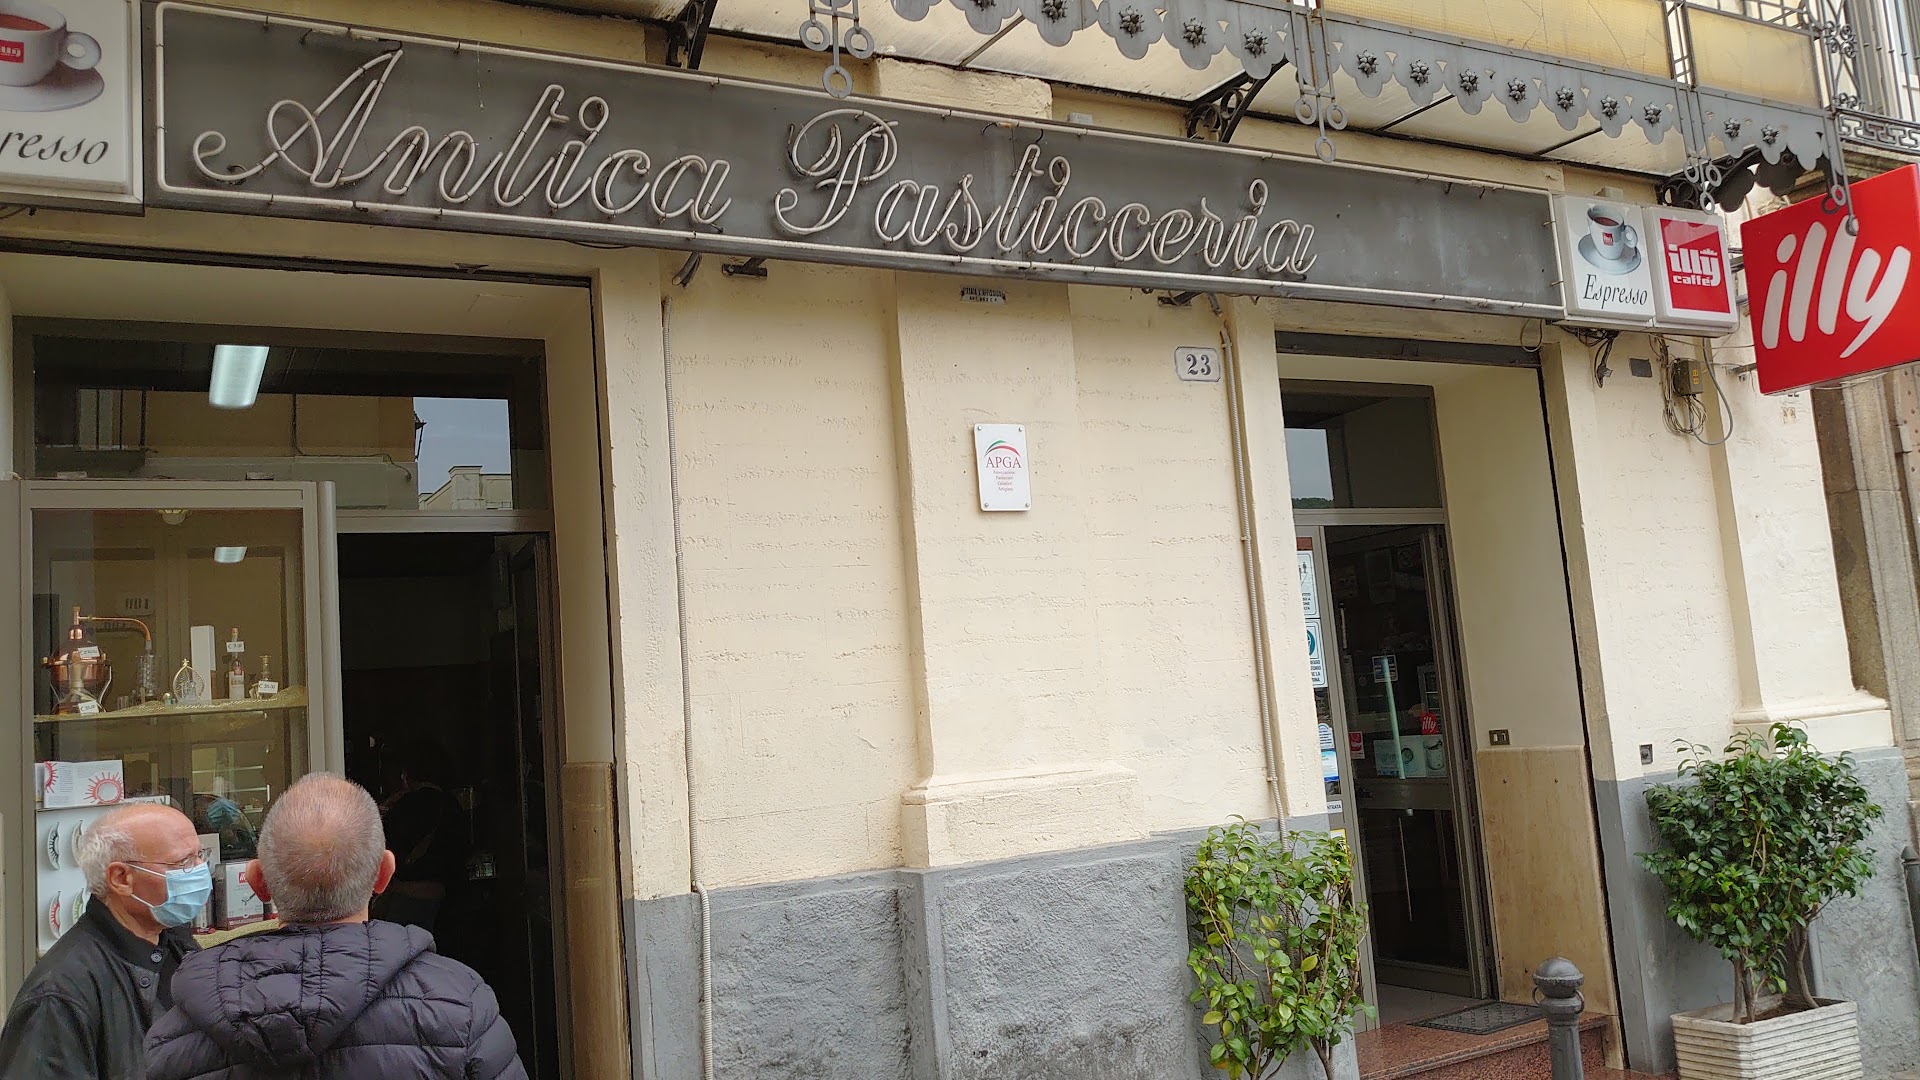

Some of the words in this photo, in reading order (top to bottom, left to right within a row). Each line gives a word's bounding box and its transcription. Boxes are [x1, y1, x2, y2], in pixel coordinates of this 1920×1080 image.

[0, 45, 21, 57] lly
[193, 48, 732, 224] Antica
[774, 108, 1318, 276] Pasticceria
[1668, 243, 1721, 287] illy
[1583, 273, 1648, 309] Espresso
[1761, 214, 1912, 359] illy
[1186, 354, 1211, 376] 23
[986, 456, 1022, 469] APGA
[1422, 715, 1437, 733] illy
